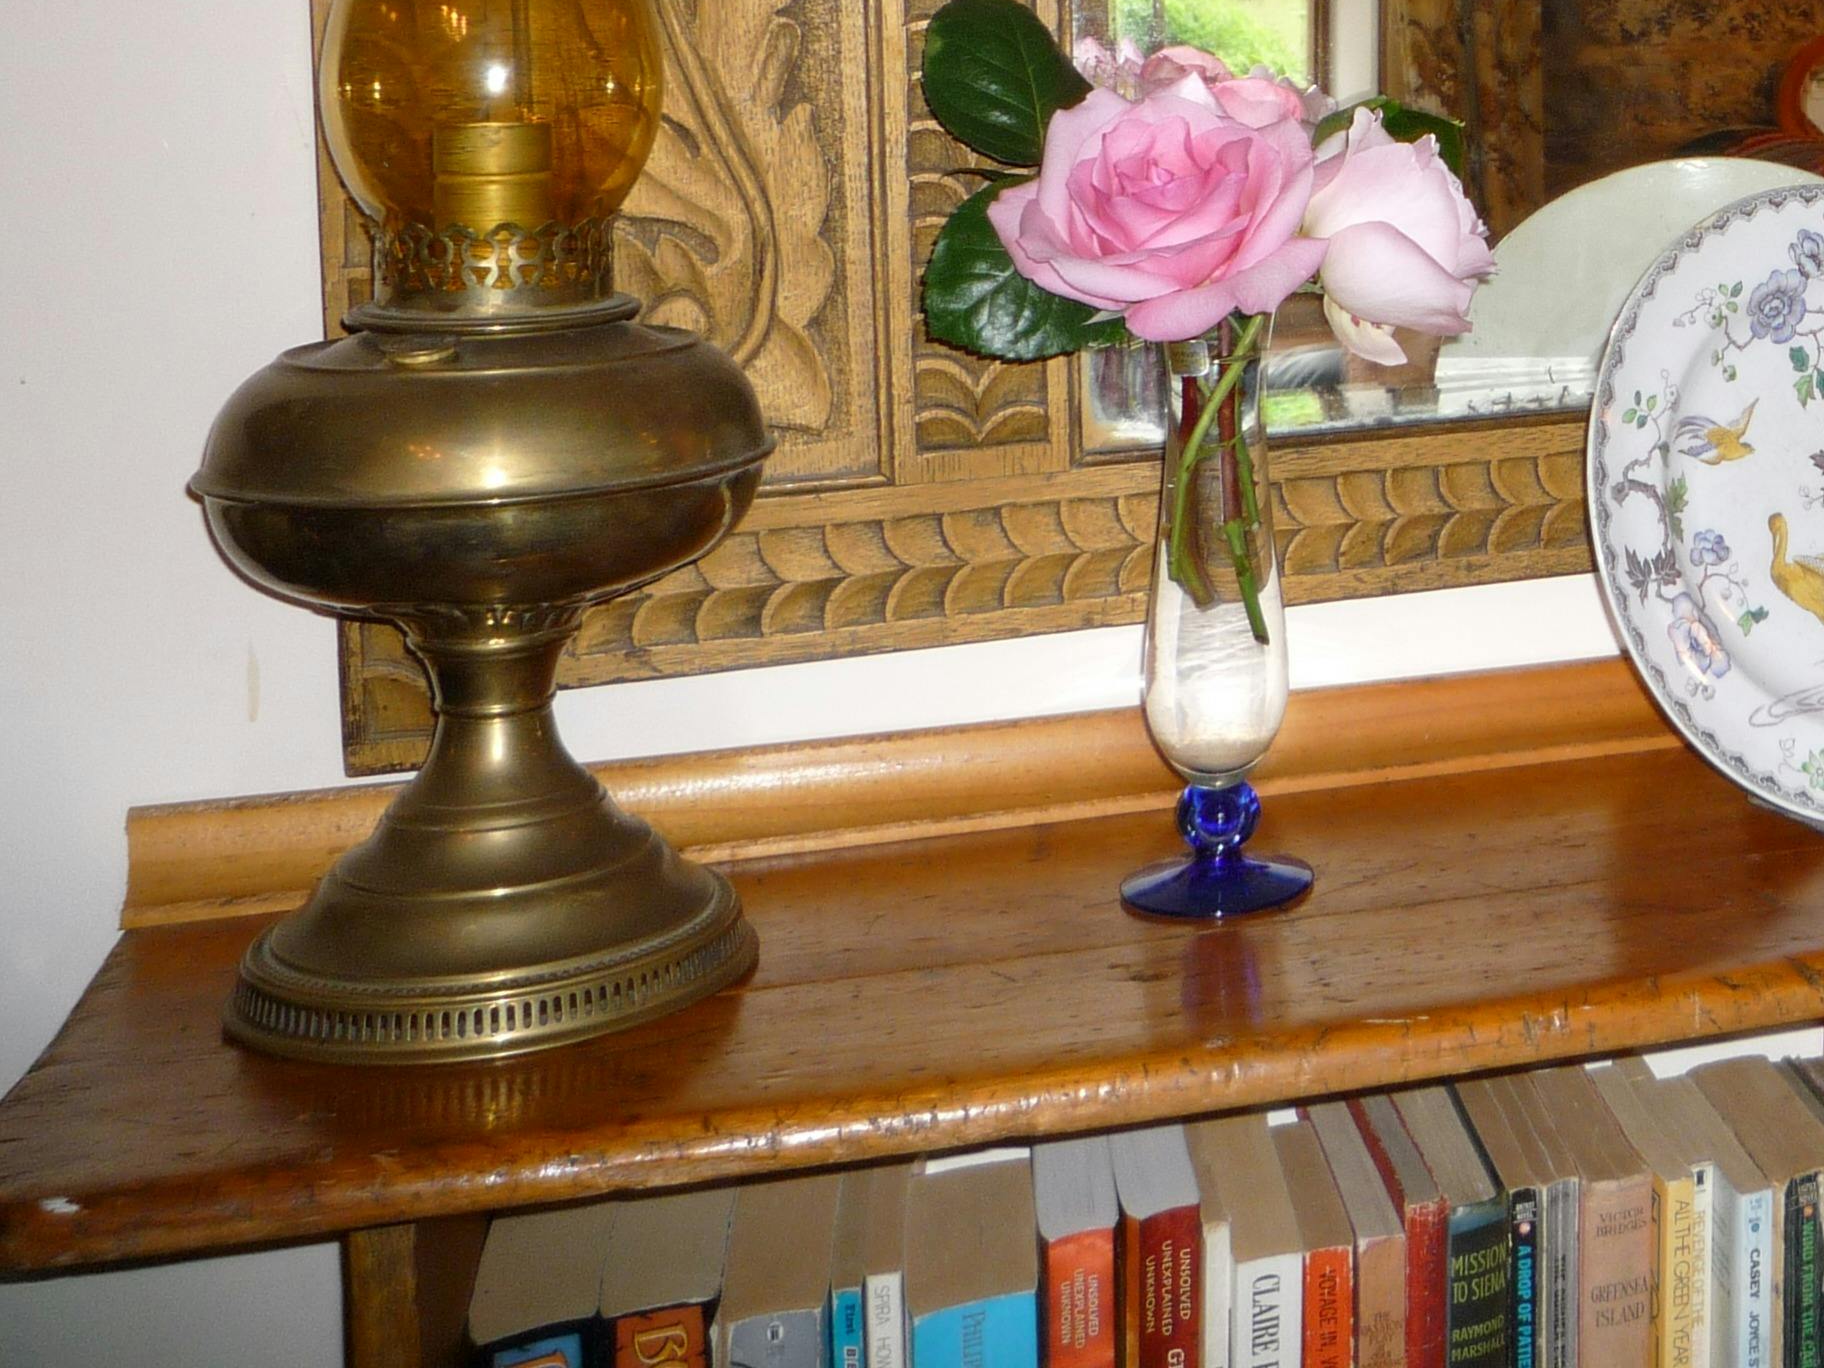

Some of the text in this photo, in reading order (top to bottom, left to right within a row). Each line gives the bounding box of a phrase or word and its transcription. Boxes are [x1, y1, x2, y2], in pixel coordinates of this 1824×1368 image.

[1597, 1220, 1647, 1237] BRIDGES
[1600, 1207, 1644, 1223] VICTOR
[1674, 1200, 1690, 1224] ALL
[1518, 1246, 1532, 1256] A
[1674, 1226, 1691, 1258] THE
[1802, 1220, 1815, 1259] WIND
[1451, 1242, 1507, 1278] MISSION
[1518, 1259, 1532, 1300] DROP
[1749, 1248, 1761, 1299] CASEY
[1146, 1255, 1156, 1333] UNKNOWN
[1162, 1240, 1173, 1336] UNEXPLAINED
[1179, 1248, 1191, 1320] UNSOLVED
[1318, 1269, 1337, 1328] VOYAGE
[1453, 1271, 1506, 1304] TO SIENA
[1591, 1276, 1648, 1303] GREENSEA
[1673, 1261, 1691, 1321] GREEN
[1802, 1263, 1815, 1306] FROM
[1061, 1281, 1071, 1344] UNKNOWN
[1074, 1268, 1086, 1349] UNEXPLAINED
[1088, 1274, 1098, 1336] UNSOLVED
[1252, 1274, 1280, 1356] CLAIRE
[1518, 1304, 1532, 1322] OF
[1596, 1302, 1645, 1328] ISLAND
[1802, 1308, 1815, 1336] THE
[1451, 1334, 1505, 1362] MARSHALL
[1452, 1315, 1505, 1342] RAYMOND
[1748, 1310, 1760, 1353] JOYCE
